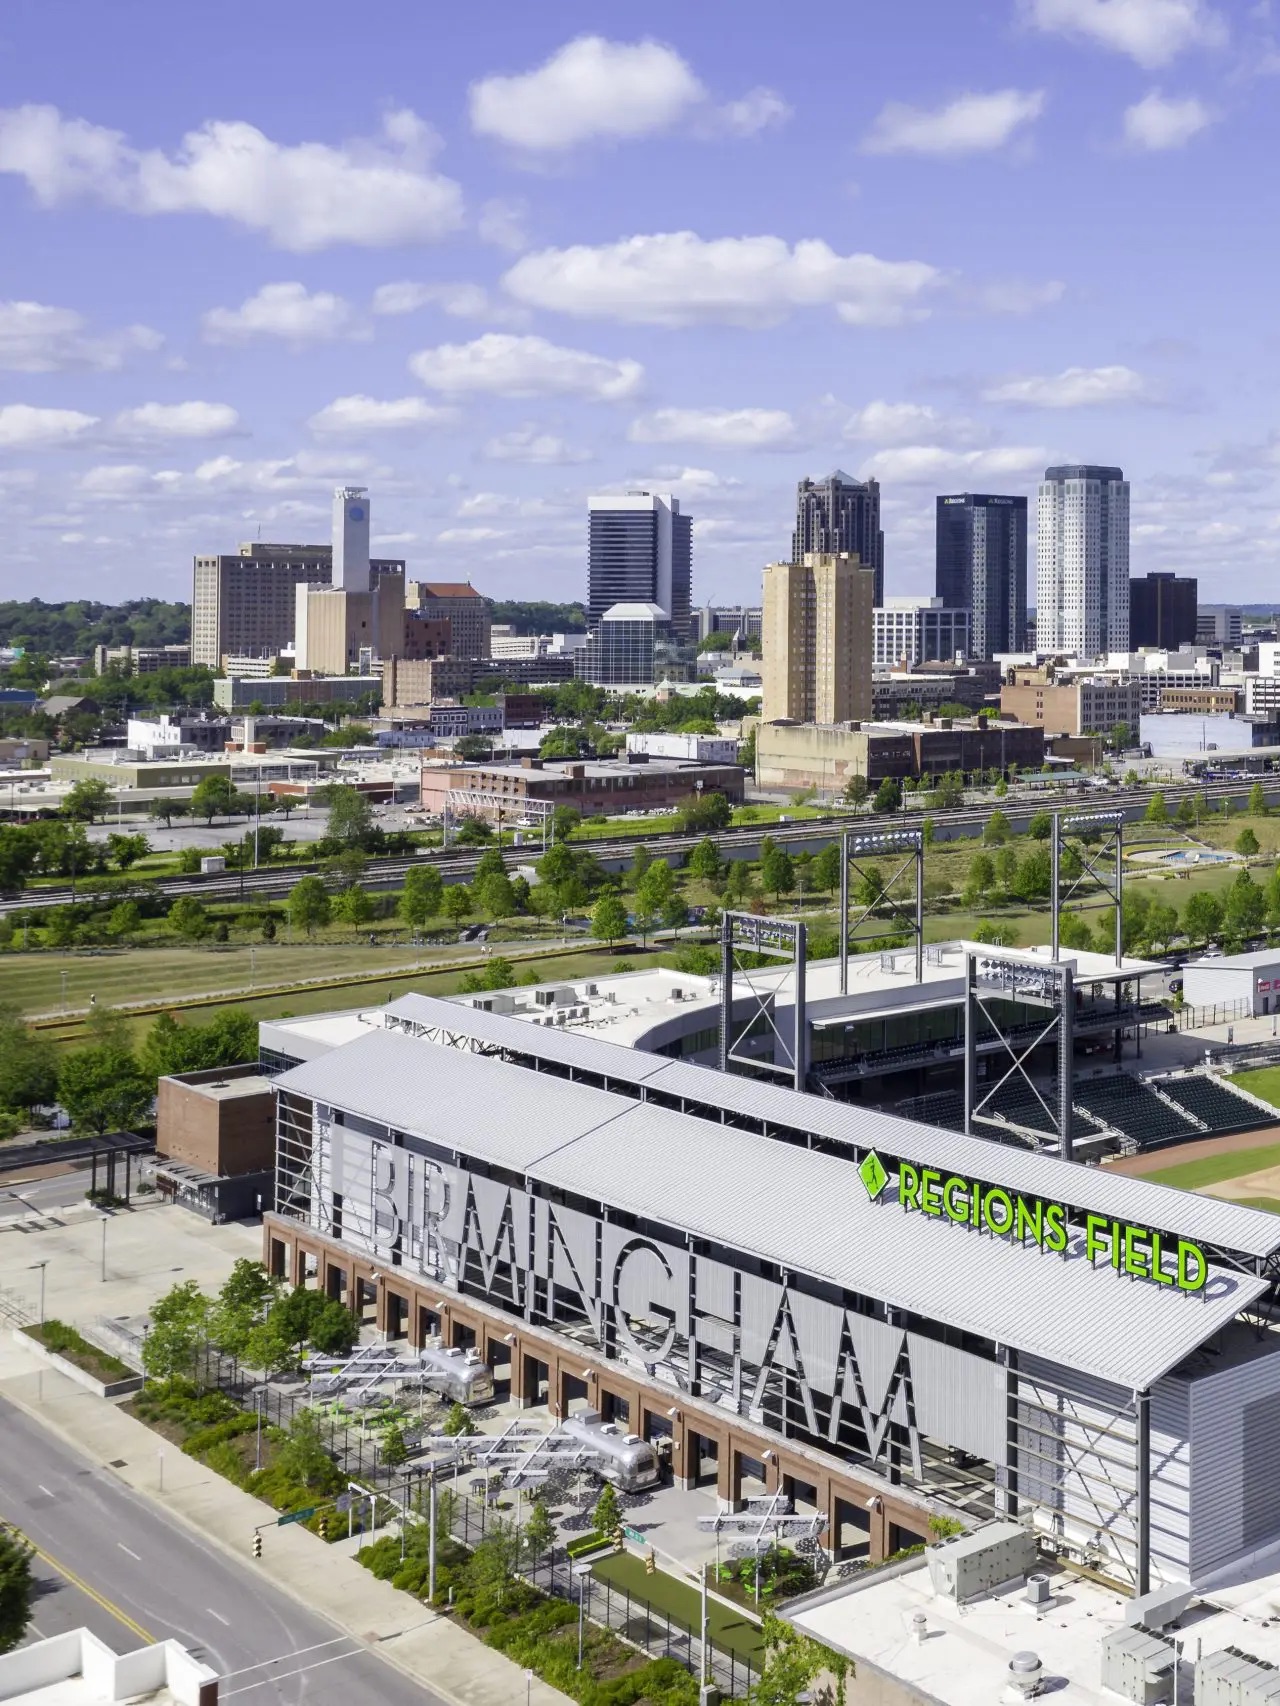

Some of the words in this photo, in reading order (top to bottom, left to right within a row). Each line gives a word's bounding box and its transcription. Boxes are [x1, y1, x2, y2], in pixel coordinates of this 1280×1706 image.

[369, 1140, 923, 1481] BIRMINGHAM
[899, 1163, 1069, 1253] REGIONS
[1086, 1214, 1209, 1292] FIELD
